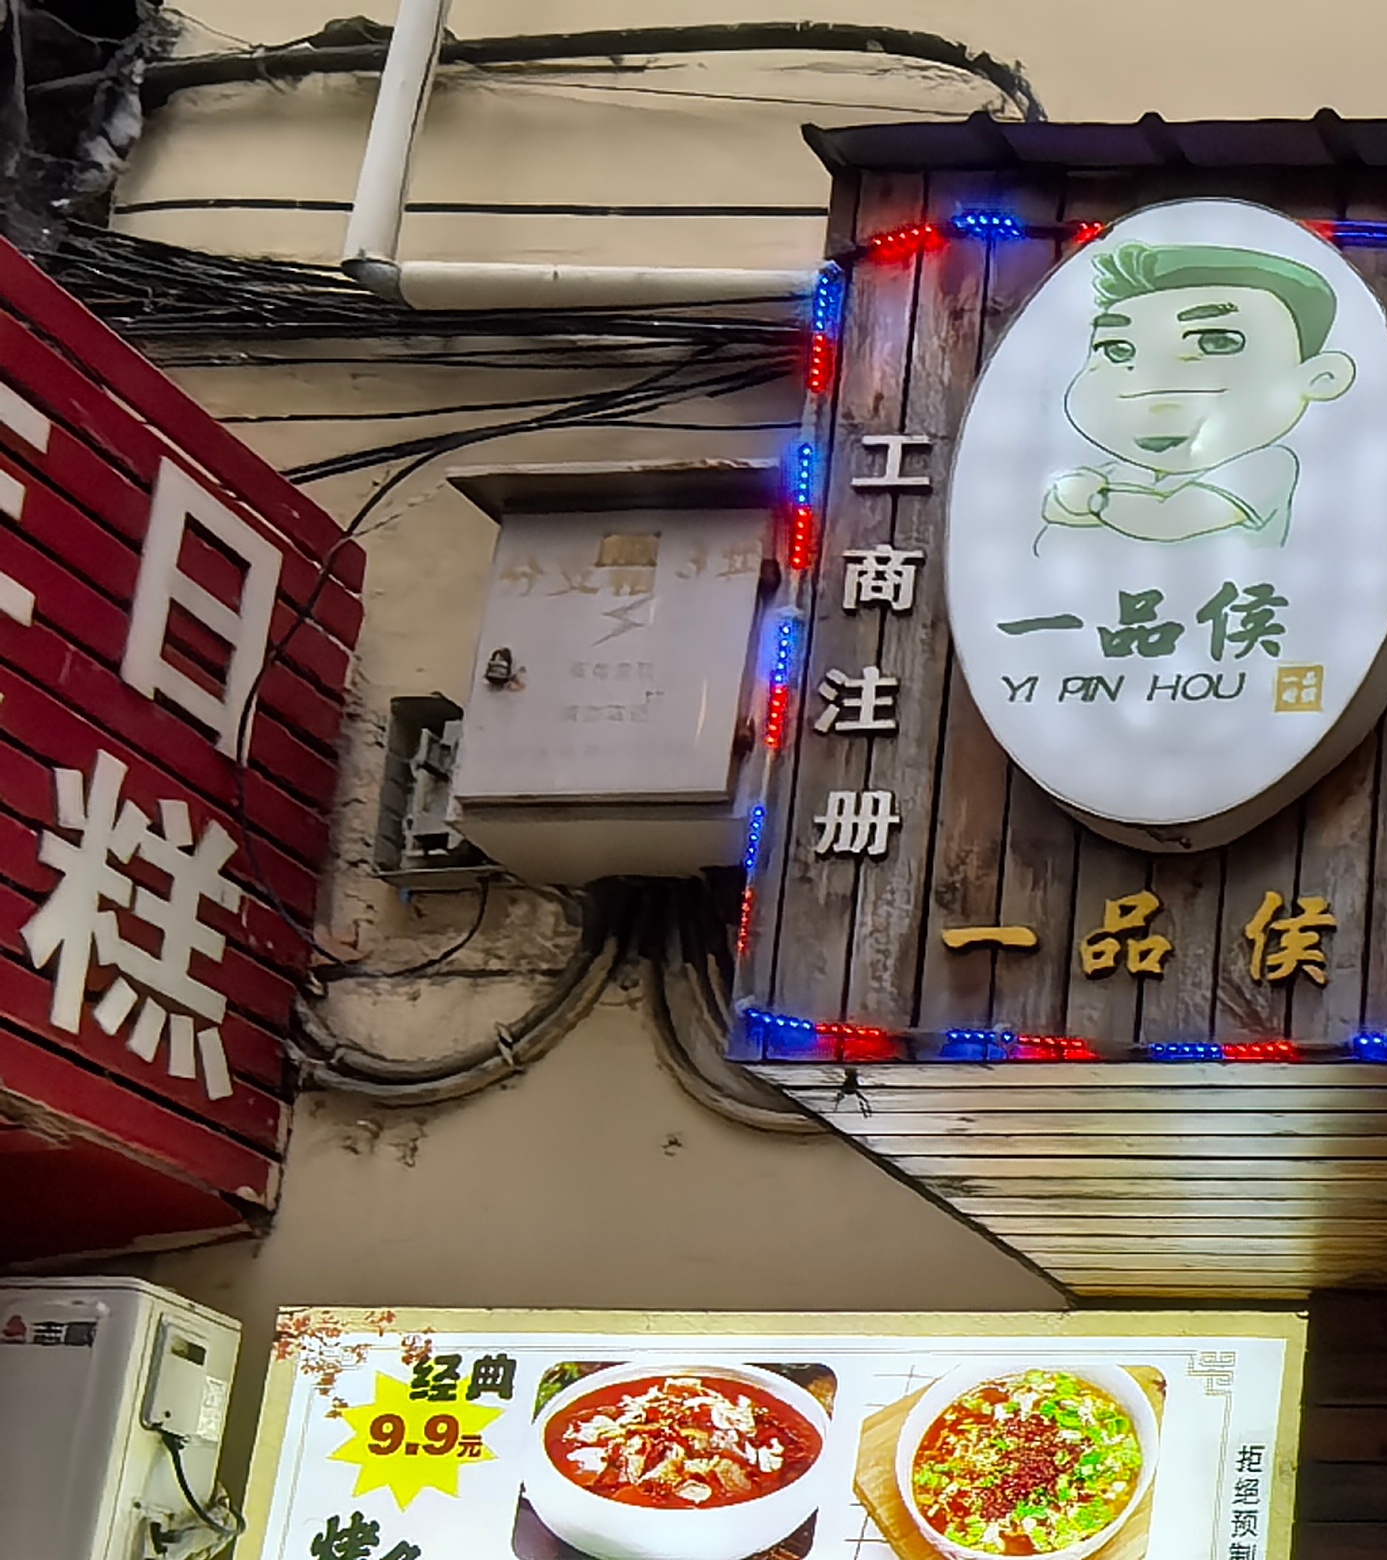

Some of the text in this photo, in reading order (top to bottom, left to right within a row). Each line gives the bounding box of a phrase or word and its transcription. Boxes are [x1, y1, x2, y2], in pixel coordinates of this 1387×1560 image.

[814, 434, 934, 856] 工商注册
[997, 581, 1289, 661] 一品侯
[1001, 675, 1038, 703] YI
[1058, 675, 1125, 702] PIN
[1147, 671, 1247, 702] HOU
[19, 749, 243, 1101] 糕
[409, 1353, 518, 1402] 经典
[368, 1413, 485, 1459] 9.9元
